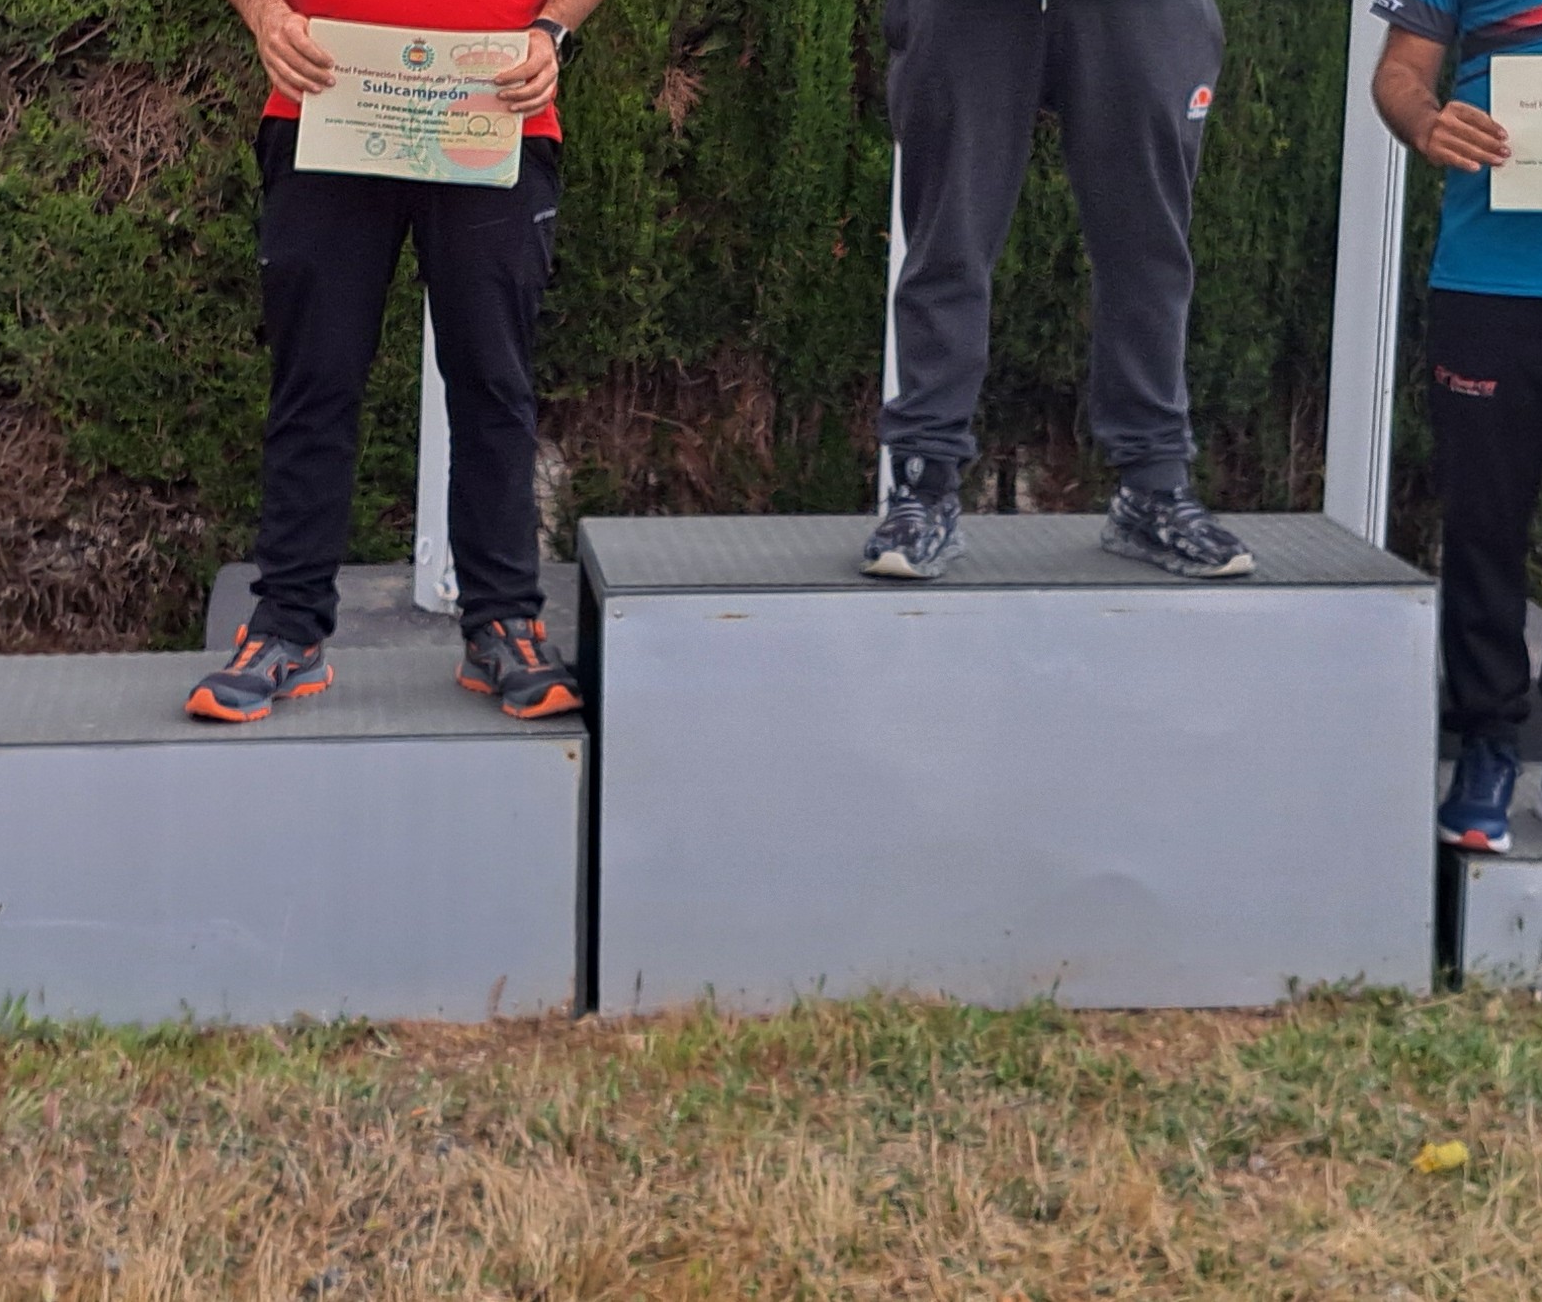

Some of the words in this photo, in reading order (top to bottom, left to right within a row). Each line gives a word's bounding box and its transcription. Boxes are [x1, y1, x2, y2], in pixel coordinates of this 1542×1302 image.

[334, 65, 352, 74] Real
[353, 66, 396, 78] Federación
[398, 72, 433, 82] Española
[362, 79, 468, 102] Subcampeón
[357, 101, 379, 109] COPA
